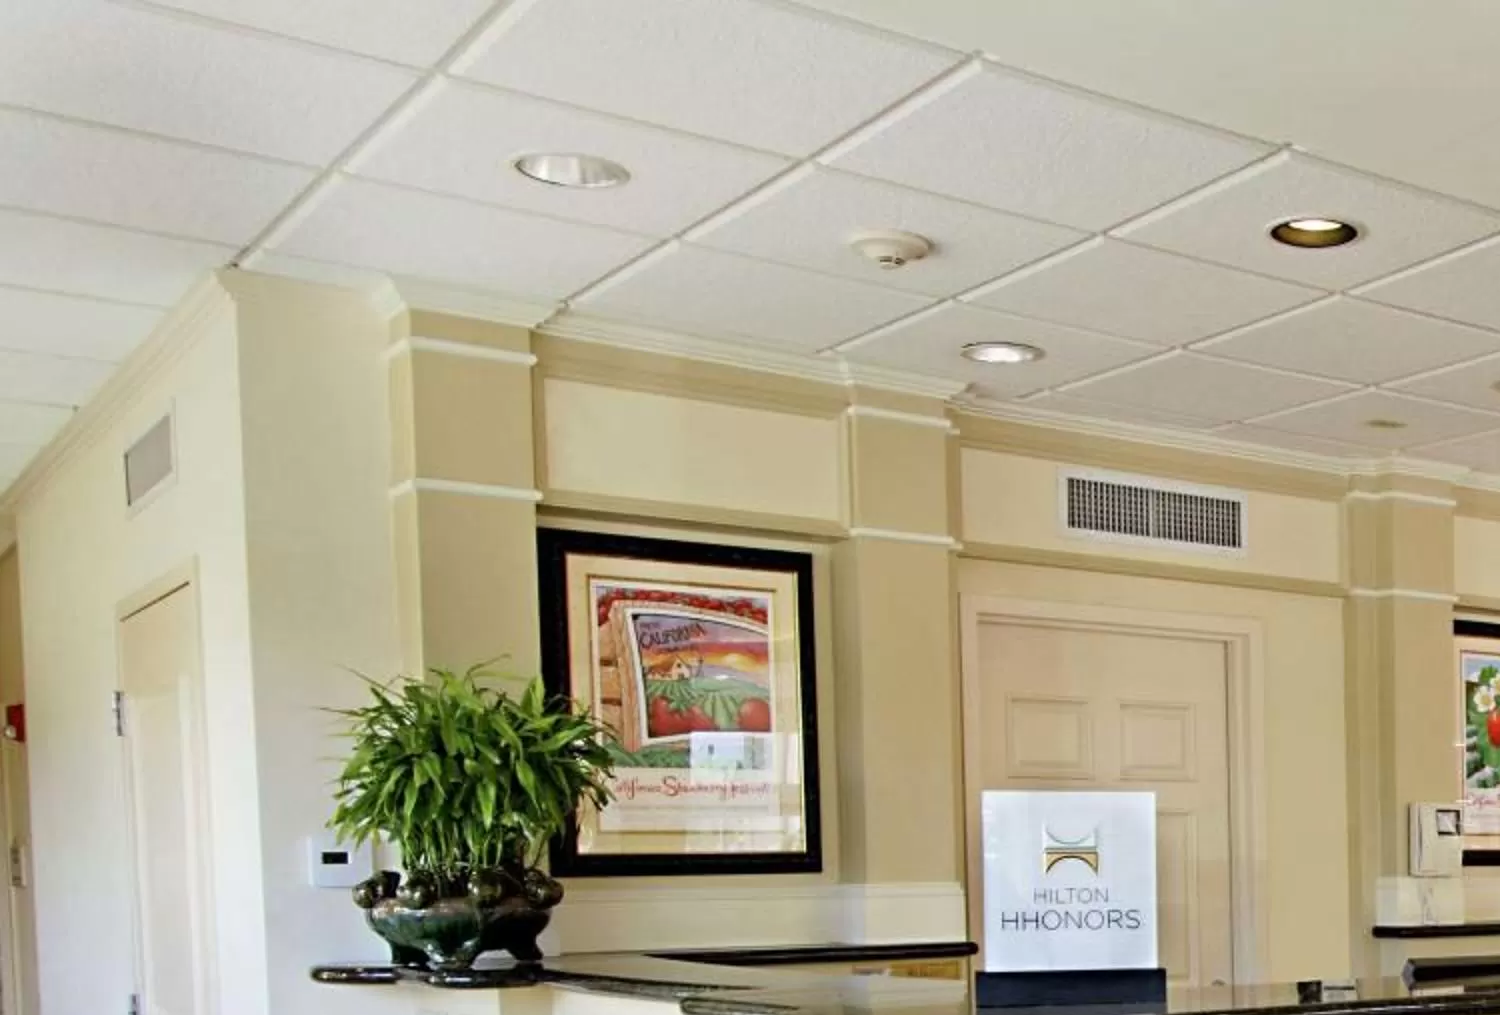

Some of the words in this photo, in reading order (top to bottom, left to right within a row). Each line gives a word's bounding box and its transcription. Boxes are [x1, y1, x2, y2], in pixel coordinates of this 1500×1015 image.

[614, 776, 660, 799] alifornia
[1033, 887, 1109, 904] HILTON
[1001, 909, 1141, 931] HHONORS
